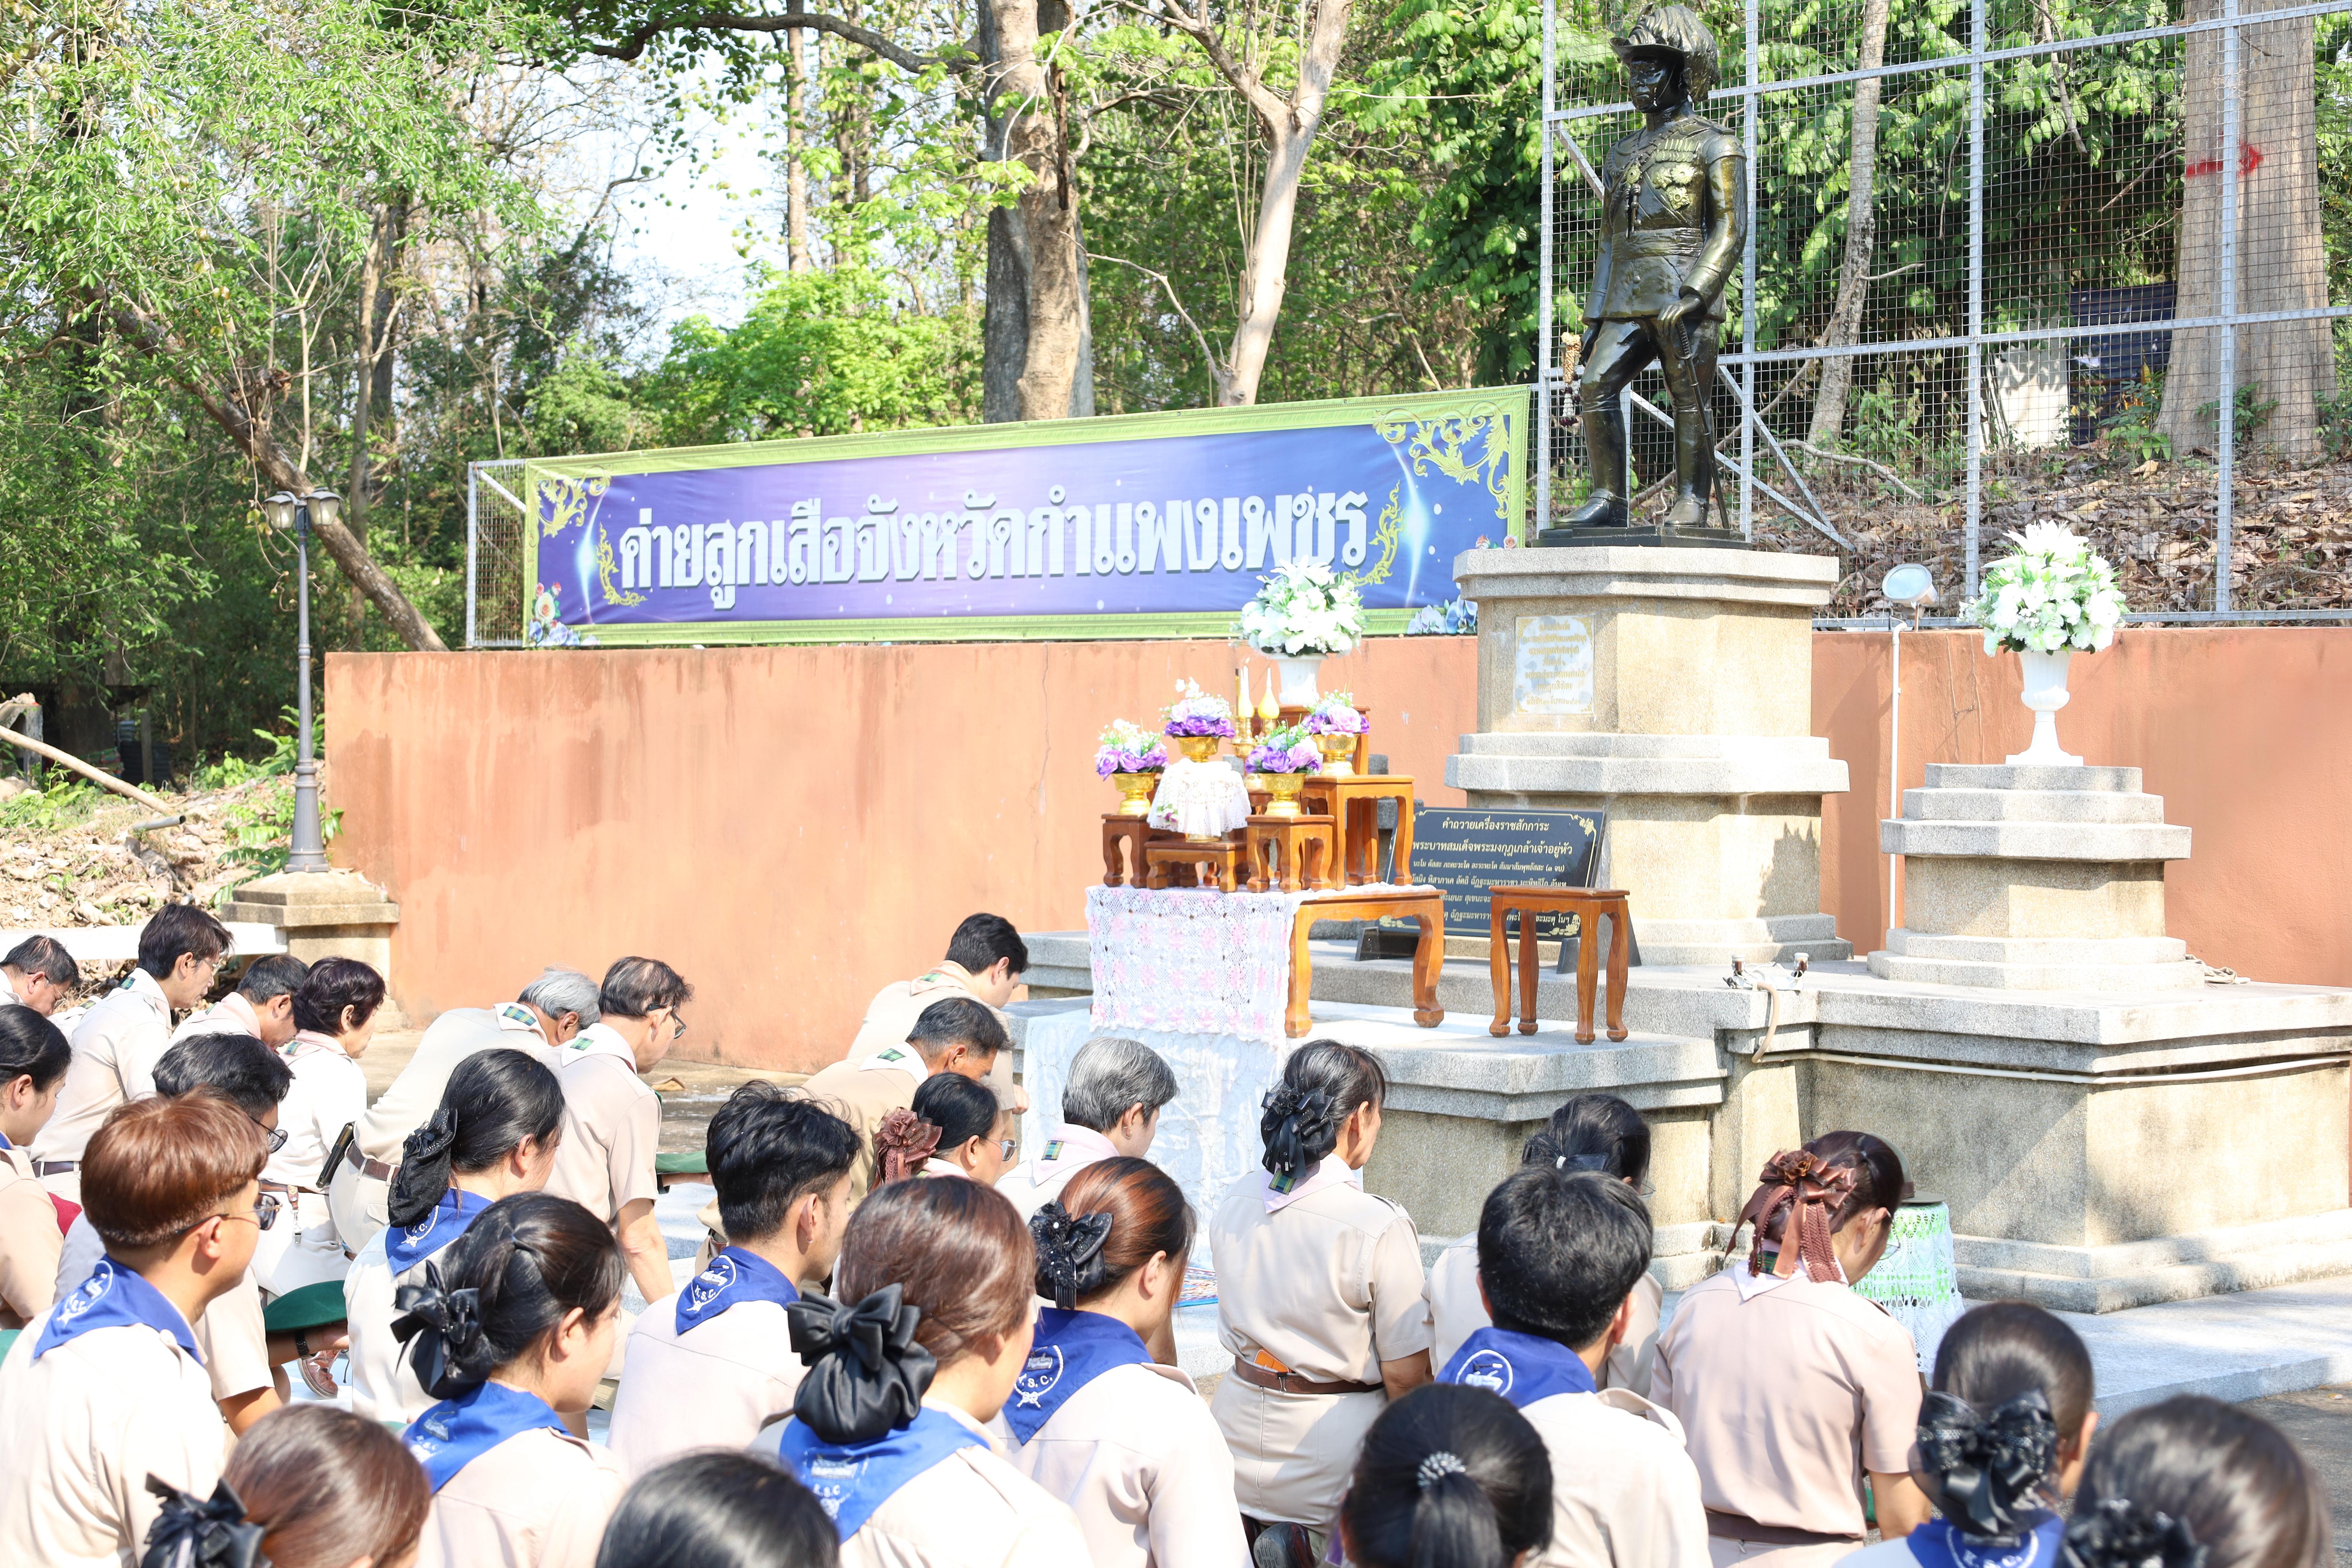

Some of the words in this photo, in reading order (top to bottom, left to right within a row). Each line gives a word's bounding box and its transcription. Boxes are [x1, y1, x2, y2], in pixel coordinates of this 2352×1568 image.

[620, 484, 1368, 610] ค่ายลูกเสือจังหวัดกำแพงเพชร
[1442, 815, 1550, 831] คำถวายเครื่องราชสักการะ
